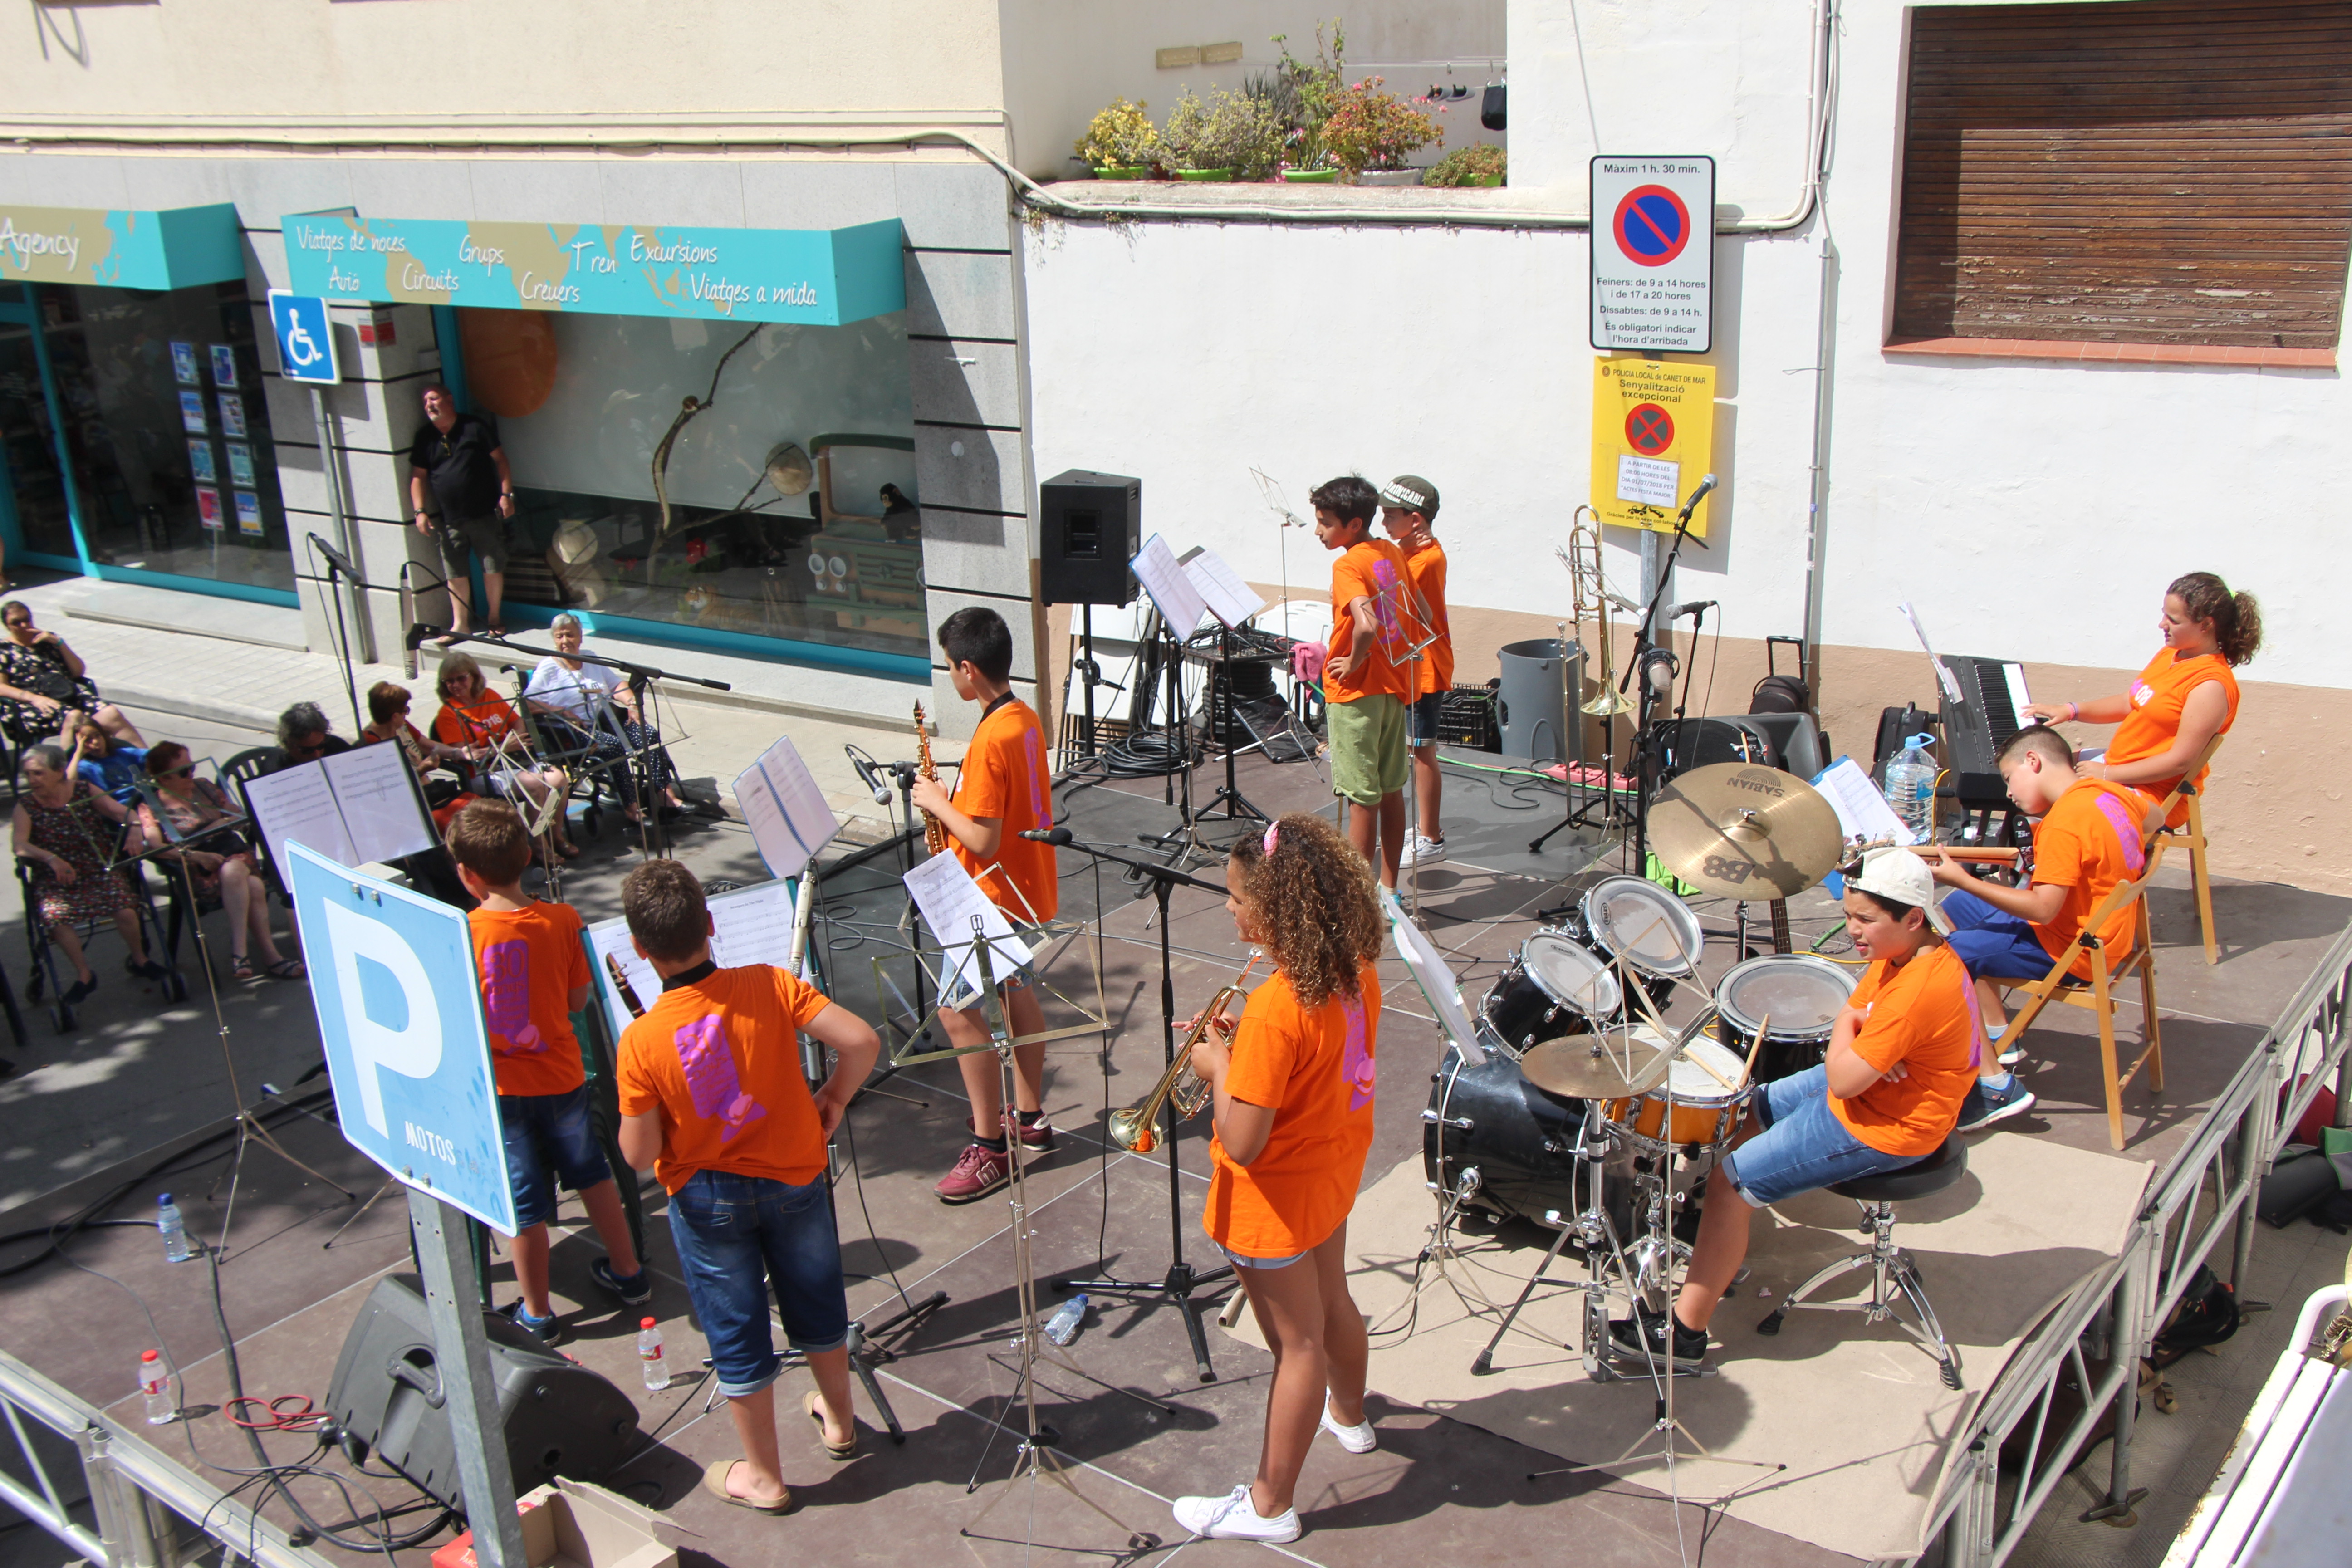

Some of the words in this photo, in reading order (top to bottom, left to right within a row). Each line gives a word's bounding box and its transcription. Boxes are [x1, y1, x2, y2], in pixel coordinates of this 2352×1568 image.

[1604, 163, 1638, 173] Màxim
[1642, 165, 1646, 173] 1
[1650, 164, 1660, 174] h.
[1663, 164, 1675, 174] 30
[1678, 164, 1700, 174] min.
[0, 217, 81, 273] Agency
[296, 225, 344, 263] Viatges
[350, 230, 366, 252] de
[371, 235, 406, 253] noces
[458, 234, 505, 277] Grups
[572, 240, 617, 274] Tren
[630, 234, 718, 265] Excursions
[402, 263, 459, 292] Circuits
[521, 271, 581, 303] Creuers
[1597, 277, 1633, 287] Feiners:
[1636, 279, 1647, 287] de
[1650, 279, 1655, 287] 9
[1666, 279, 1677, 288] 14
[1679, 279, 1706, 289] hores
[691, 272, 750, 317] Viatges
[756, 288, 767, 304] a
[772, 280, 818, 307] mida
[1616, 290, 1627, 299] de
[1631, 291, 1641, 299] 17
[1651, 291, 1662, 299] 20
[1665, 291, 1691, 300] hores
[1600, 305, 1647, 316] Dissabtes:
[1650, 308, 1661, 316] de
[1664, 308, 1670, 316] 9
[1681, 308, 1691, 316] 14
[1693, 309, 1703, 317] h.
[1605, 320, 1617, 331] És
[1618, 323, 1663, 335] obligatori
[1665, 324, 1697, 334] indicar
[1619, 379, 1685, 393] Senyalització
[1635, 371, 1654, 380] LOCAL
[1663, 373, 1682, 382] CANET
[1692, 377, 1706, 385] MAR
[1622, 391, 1681, 403] excepcional
[1632, 461, 1651, 469] PARTIR
[1632, 479, 1663, 489] 01/07/2018
[1726, 777, 1785, 798] SABIAN
[1702, 854, 1756, 885] B8
[490, 947, 525, 983] 30
[323, 897, 443, 1140] P
[681, 1024, 722, 1067] 30
[405, 1120, 456, 1166] MOTOS
